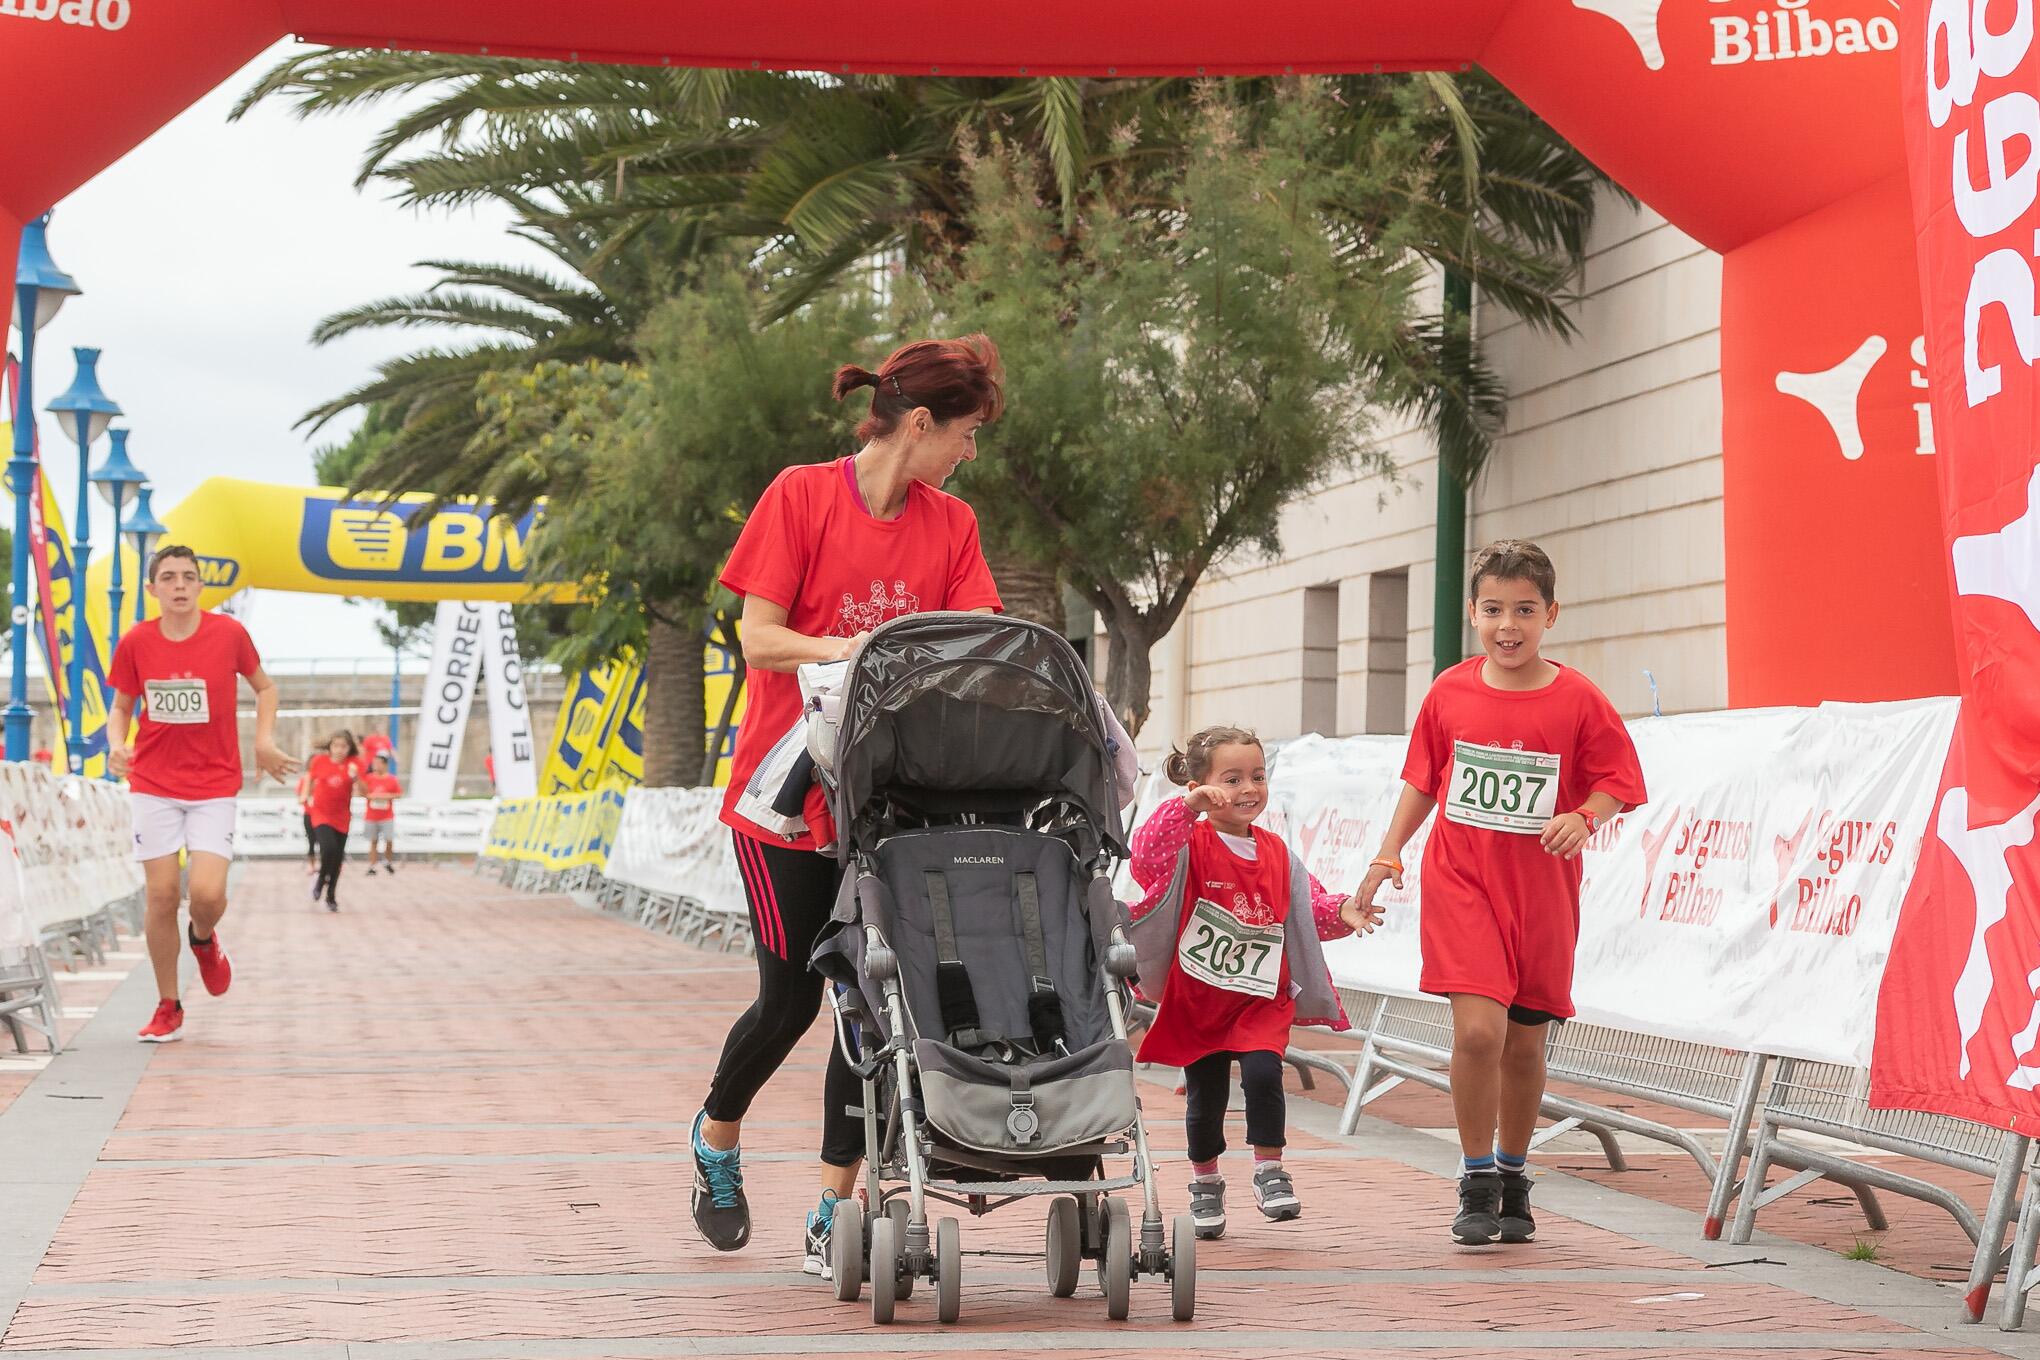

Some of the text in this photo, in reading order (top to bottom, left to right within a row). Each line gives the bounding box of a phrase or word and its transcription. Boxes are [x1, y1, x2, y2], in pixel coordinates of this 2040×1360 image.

[1709, 9, 1900, 66] Bilbao
[153, 691, 202, 712] 2009
[428, 733, 454, 770] EL
[512, 729, 530, 762] EL
[1460, 767, 1547, 814] 2037
[954, 856, 1004, 864] MACLAREN
[1674, 806, 1752, 869] Seguros
[1660, 872, 1724, 927] Bilbao
[1791, 877, 1862, 937] Bilbao
[1187, 924, 1271, 976] 2037
